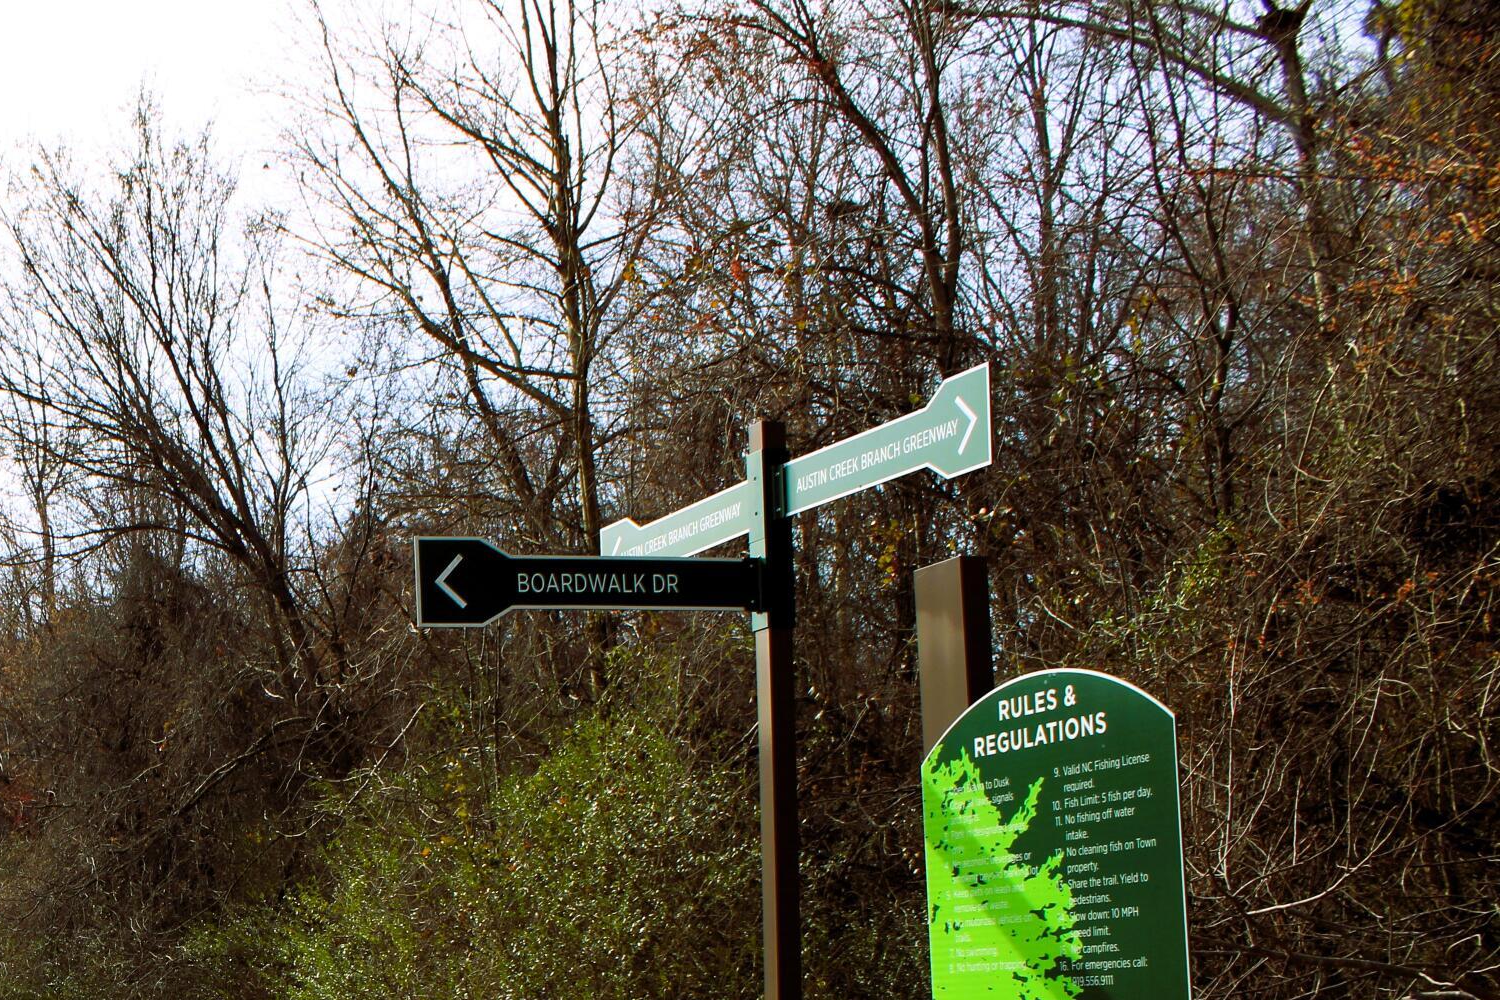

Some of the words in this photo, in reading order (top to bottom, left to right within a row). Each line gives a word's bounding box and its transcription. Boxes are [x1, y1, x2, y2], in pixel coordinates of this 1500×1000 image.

[796, 471, 827, 493] AUSTIN
[829, 458, 858, 481] CREEK
[861, 441, 900, 468] BRANCH
[903, 418, 958, 454] GREENWAY
[644, 535, 668, 554] CREEK
[668, 523, 699, 546] BRANCH
[700, 502, 741, 531] GREENWAY
[517, 573, 646, 593] BOARDWALK
[652, 573, 679, 593] DR
[998, 688, 1058, 721] RULES
[1064, 684, 1076, 707] &
[973, 711, 1108, 758] REGULATIONS
[1054, 767, 1061, 778] 9.
[1063, 764, 1080, 776] Valid
[1081, 761, 1093, 773] NC
[1094, 757, 1120, 771] Fishing
[1121, 753, 1150, 766] License
[985, 780, 993, 790] to
[994, 777, 1010, 788] Dusk
[1063, 778, 1095, 792] required.
[992, 791, 1014, 805] signals
[1052, 800, 1062, 811] 10.
[1064, 797, 1079, 809] Fish
[1080, 794, 1100, 806] Limit:
[1101, 792, 1107, 803] 5
[1108, 790, 1122, 802] fish
[1122, 789, 1136, 801] per
[1136, 786, 1153, 799] day.
[1055, 816, 1063, 827] 11.
[1065, 814, 1075, 825] No
[1076, 810, 1100, 823] fishing
[1101, 808, 1113, 819] off
[1114, 807, 1135, 818] water
[1065, 829, 1089, 841] intake.
[1066, 847, 1077, 857] No
[1078, 843, 1108, 857] cleaning
[1109, 841, 1123, 852] fish
[1124, 841, 1135, 850] on
[1136, 838, 1157, 848] Town
[1067, 861, 1099, 875] property.
[1068, 877, 1088, 889] Share
[1089, 876, 1101, 887] the
[1103, 874, 1119, 886] trail.
[1119, 872, 1139, 884] Yield
[1140, 871, 1149, 882] to
[1088, 909, 1110, 921] down:
[1111, 908, 1120, 919] 10
[1121, 906, 1140, 917] MPH
[1092, 926, 1111, 937] limit.
[1082, 942, 1120, 955] campfires.
[1071, 961, 1084, 970] For
[1085, 958, 1131, 971] emergencies
[1132, 956, 1148, 968] call:
